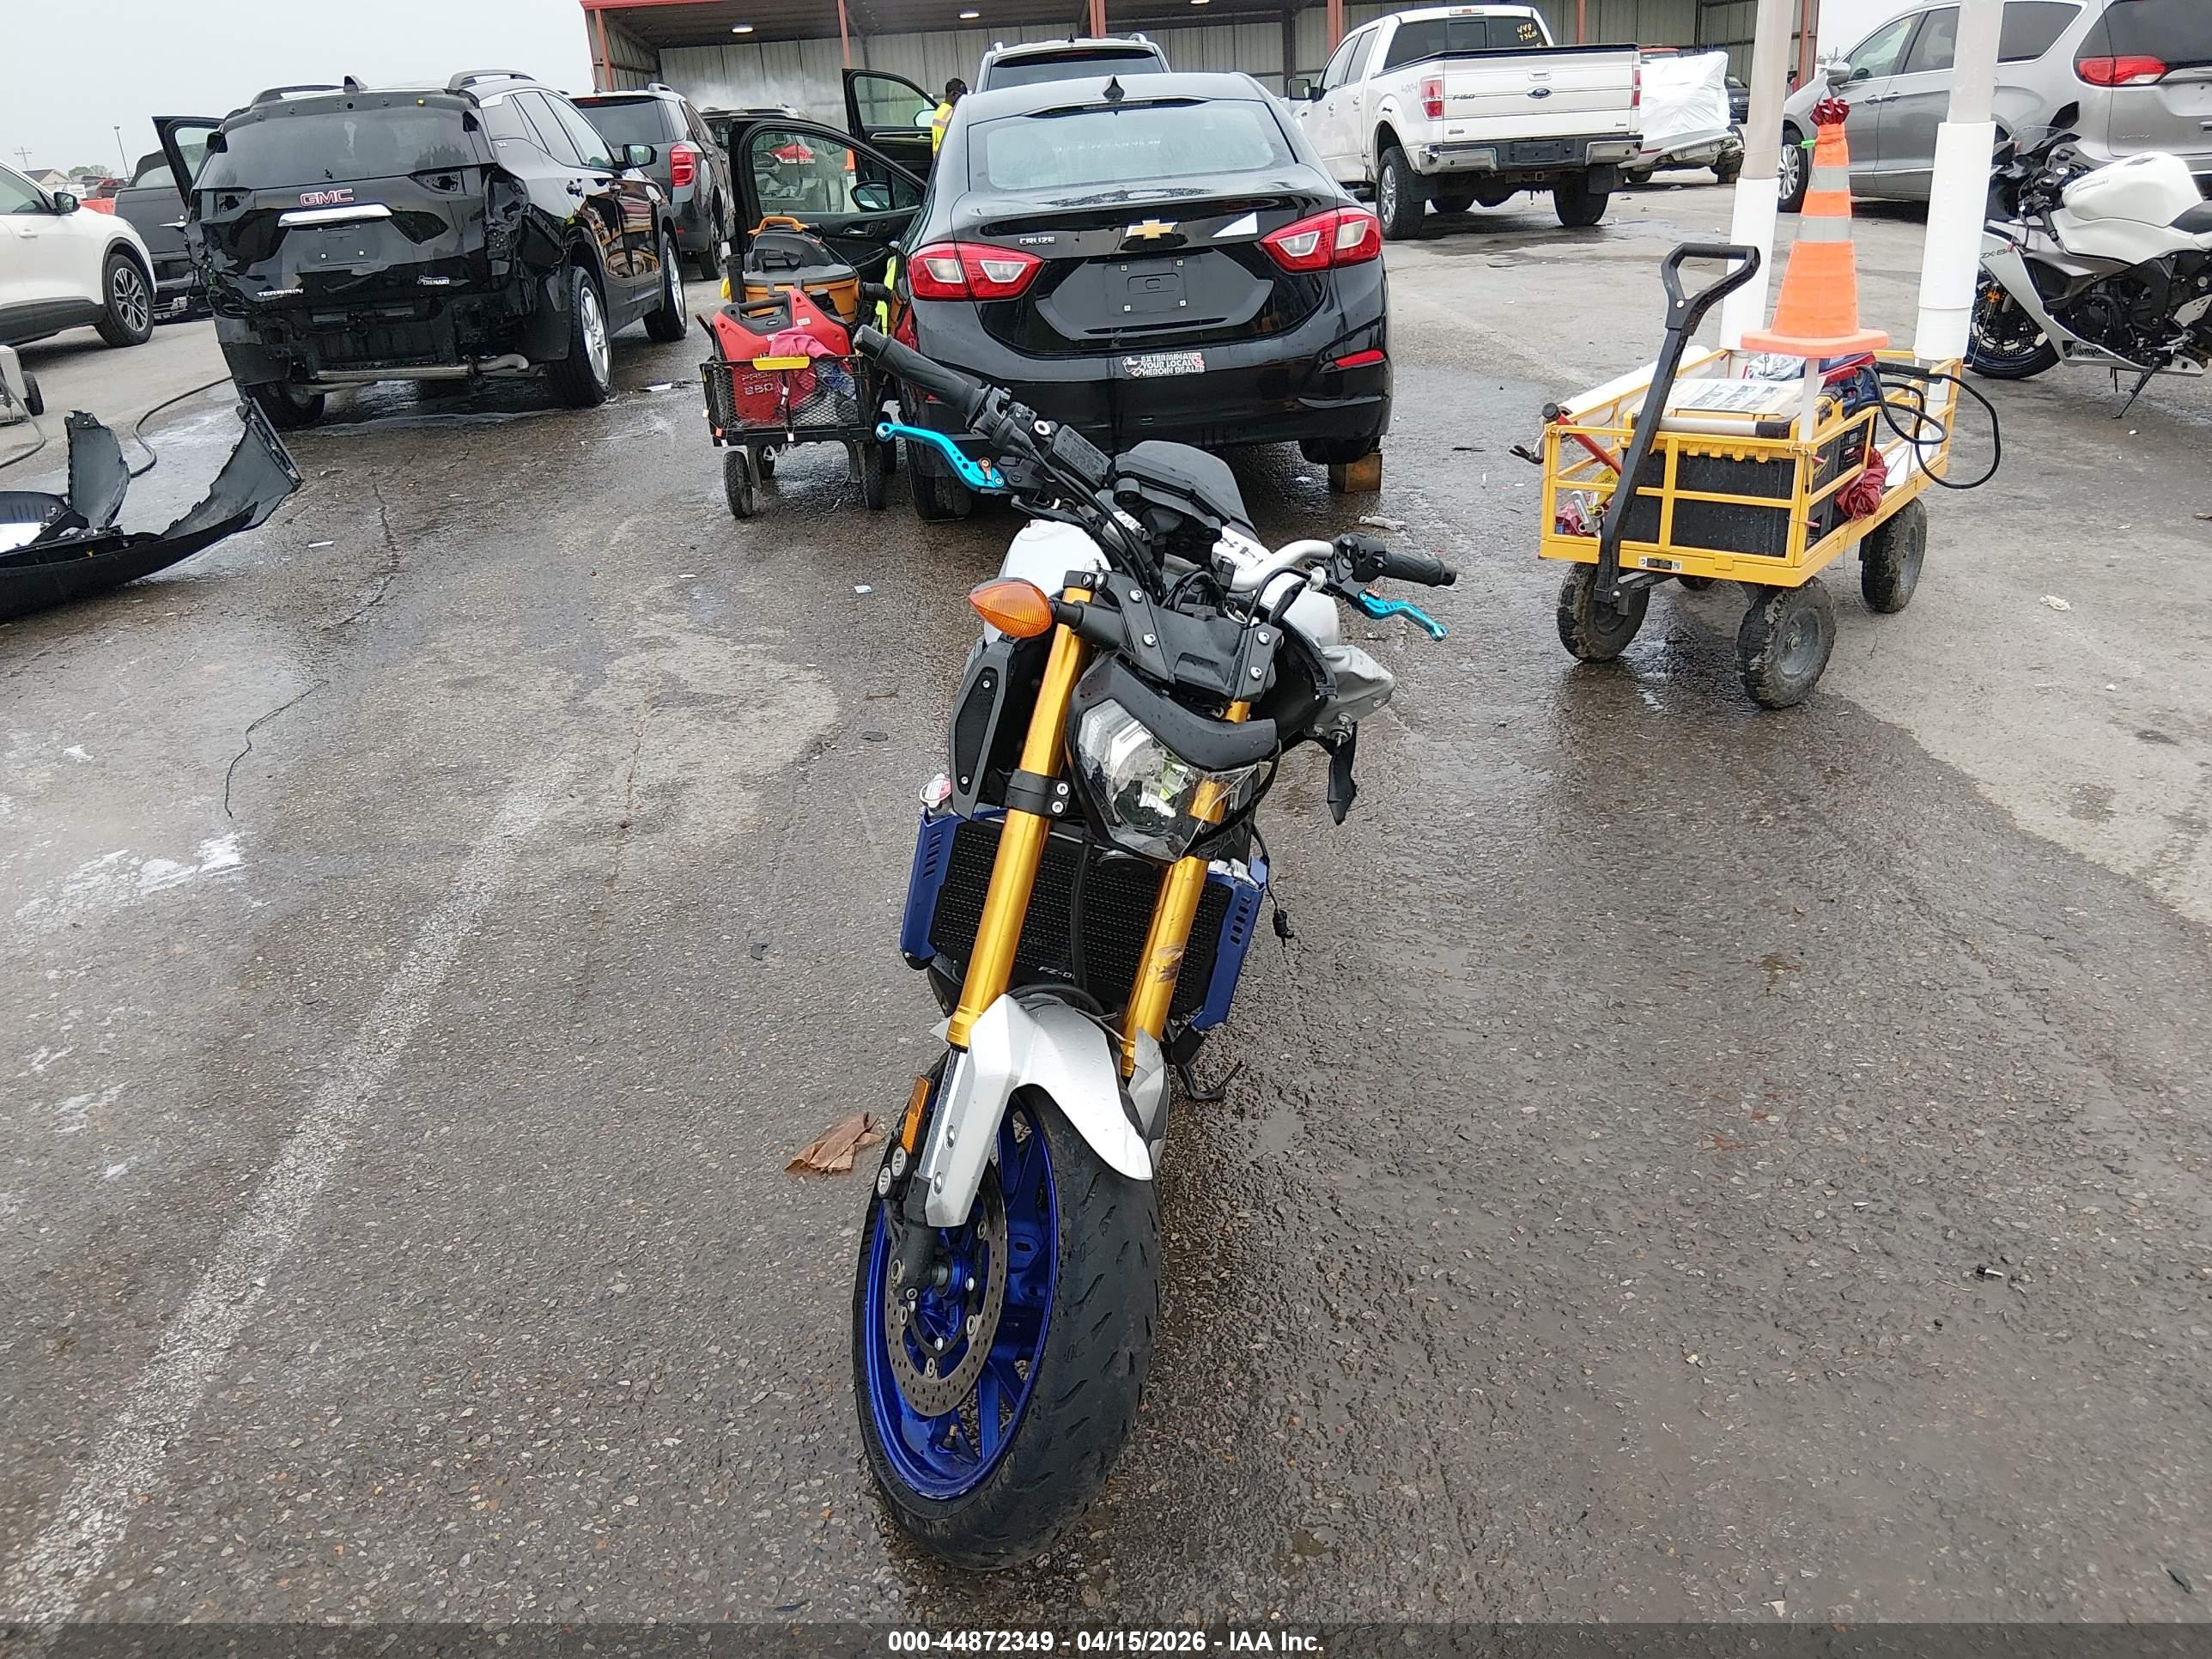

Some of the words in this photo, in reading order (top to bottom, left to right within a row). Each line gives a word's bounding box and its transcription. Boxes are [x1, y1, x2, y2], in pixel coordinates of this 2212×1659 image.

[301, 189, 355, 207] GMC
[1019, 236, 1056, 246] CRUZE
[256, 288, 304, 297] TERRAIN
[1141, 361, 1165, 369] YOUR
[1166, 359, 1193, 368] LOCAL
[1141, 367, 1174, 376] HEROIN
[1175, 364, 1206, 374] DEALER
[1038, 966, 1075, 979] FZ-0
